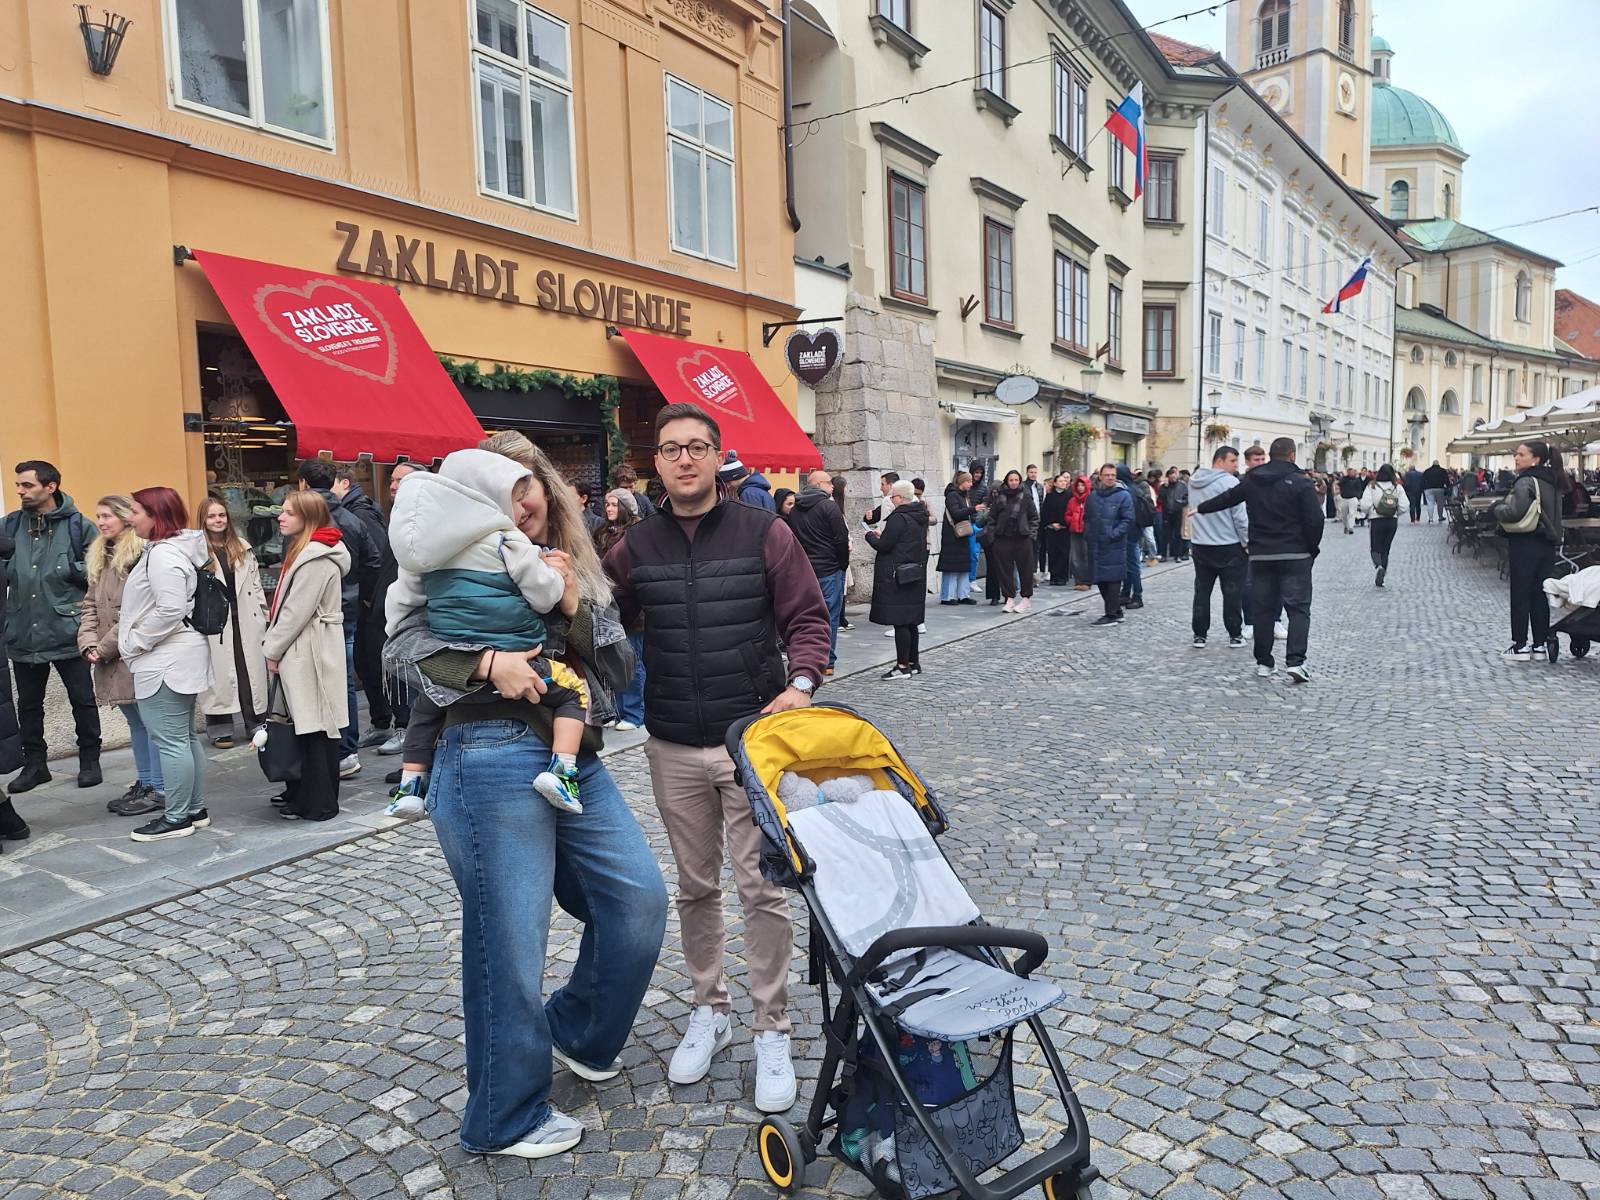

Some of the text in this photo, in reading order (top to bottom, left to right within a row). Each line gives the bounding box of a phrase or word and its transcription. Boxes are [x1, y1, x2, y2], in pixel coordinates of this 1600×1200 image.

[336, 221, 692, 337] ZAKLADI SLOVENIJE
[282, 302, 362, 328] ZAKLADI
[294, 317, 378, 343] SLOVENIJE
[799, 350, 827, 359] ZAKLADI
[692, 365, 725, 389] ZAKLADI
